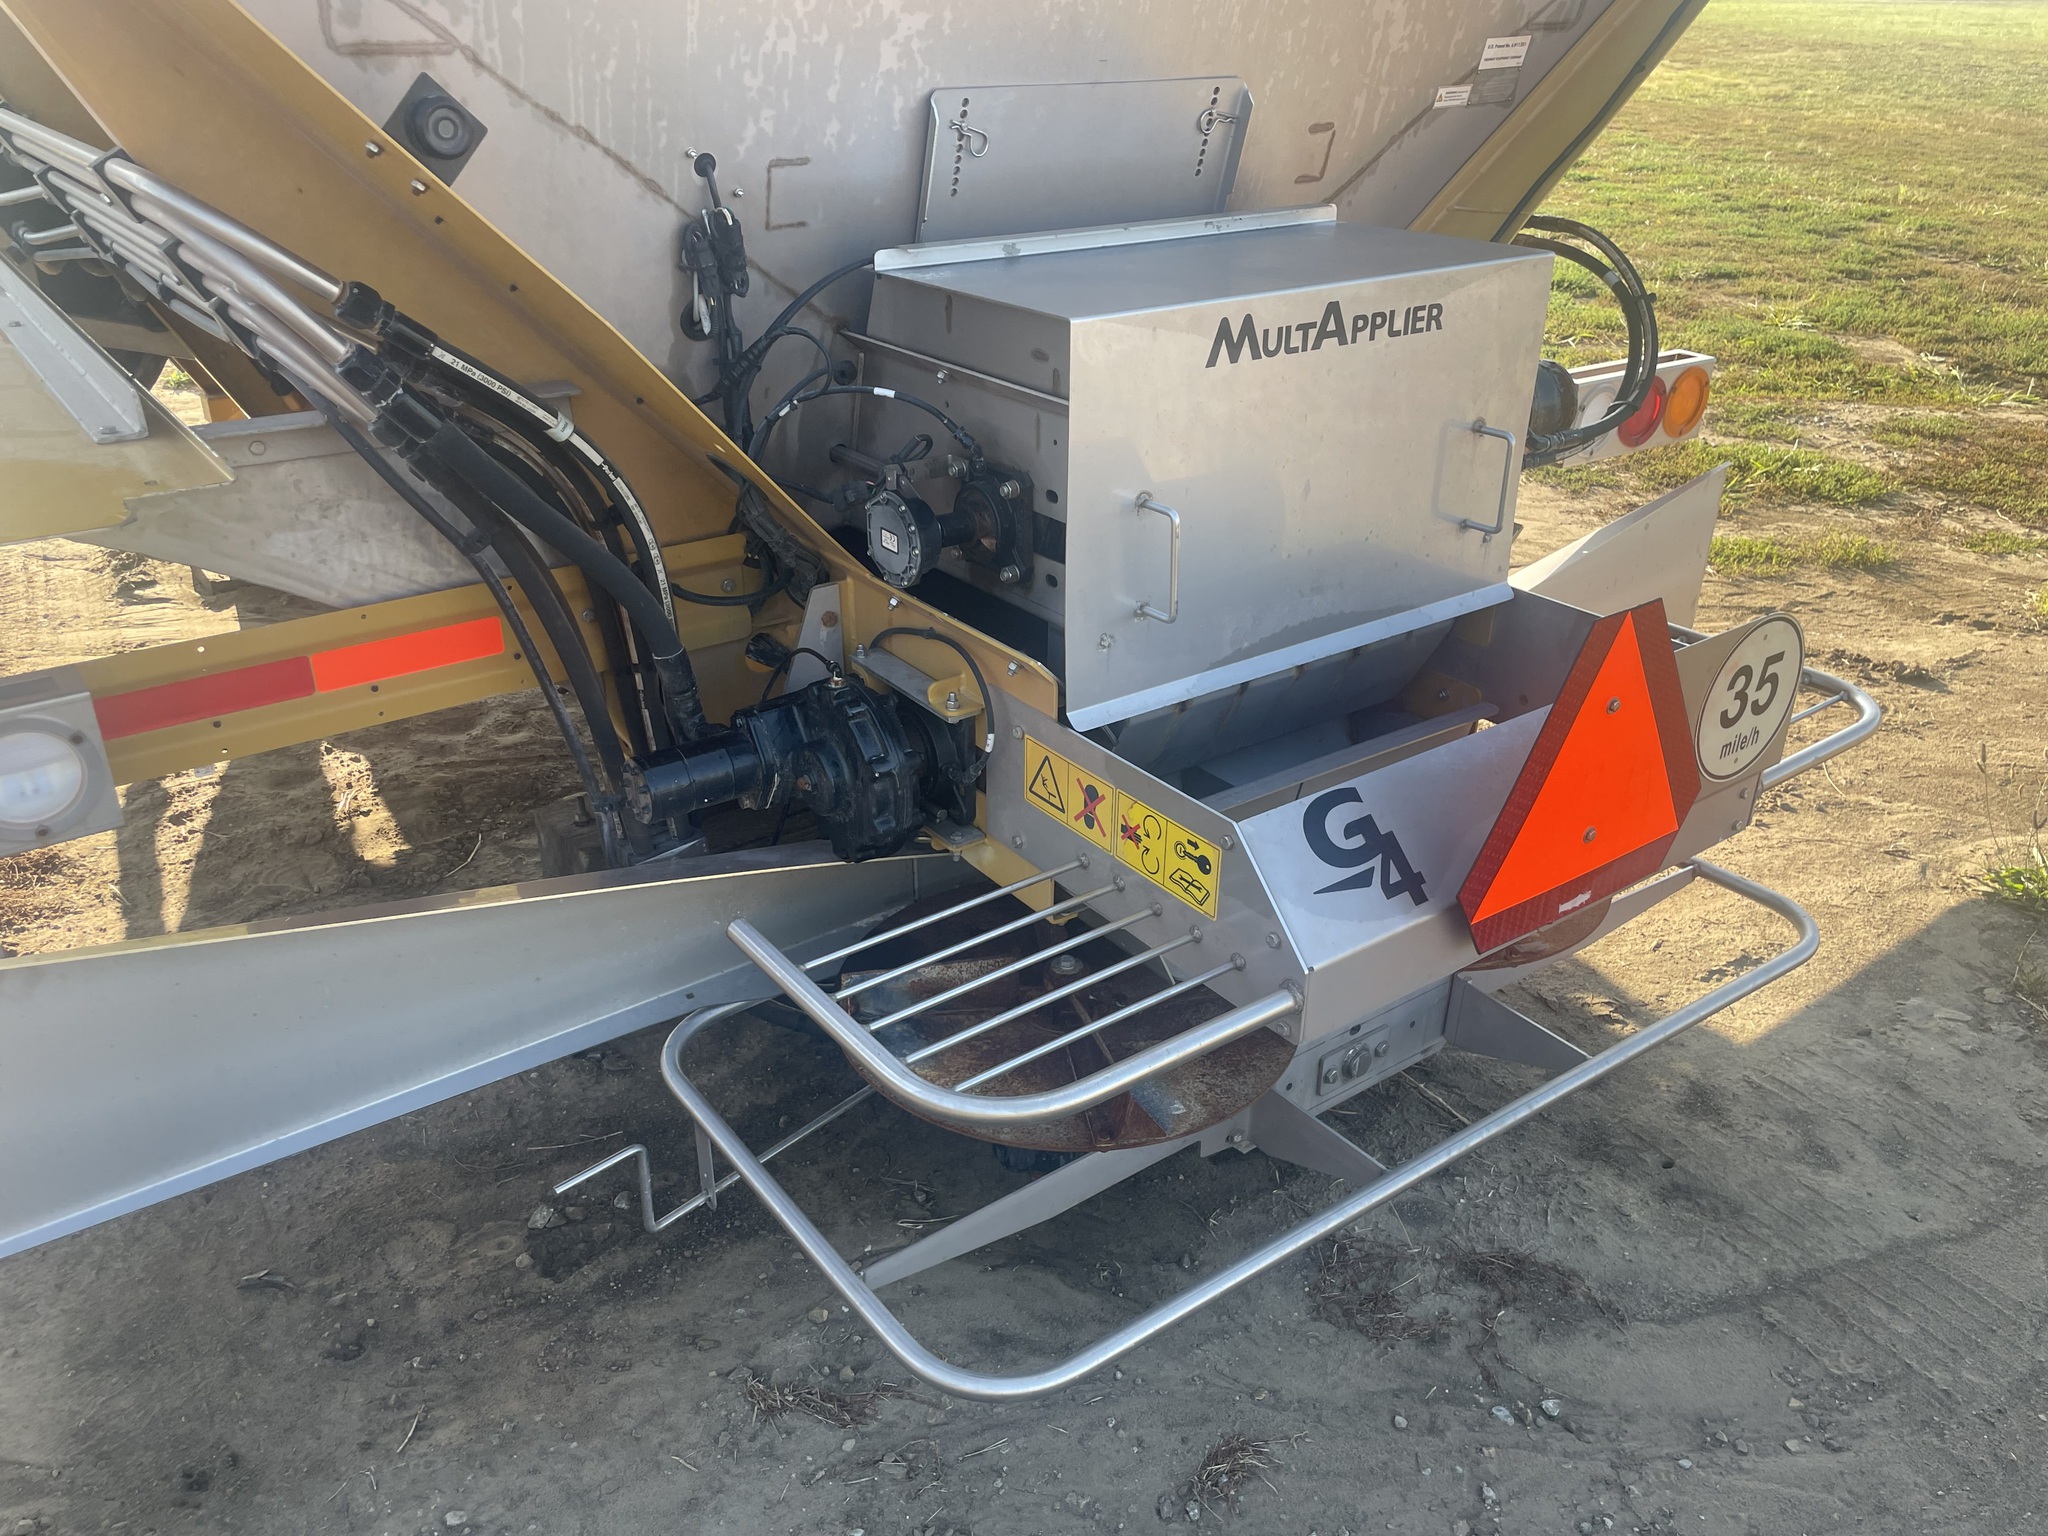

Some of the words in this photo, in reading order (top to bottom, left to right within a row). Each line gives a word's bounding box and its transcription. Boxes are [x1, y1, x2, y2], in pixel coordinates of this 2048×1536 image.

[450, 358, 460, 367] 21
[461, 364, 477, 377] MPa
[477, 372, 497, 388] (3000
[496, 385, 512, 397] PSI)
[1719, 650, 1786, 729] 35
[1719, 726, 1760, 760] mile/h
[1303, 786, 1429, 907] G4
